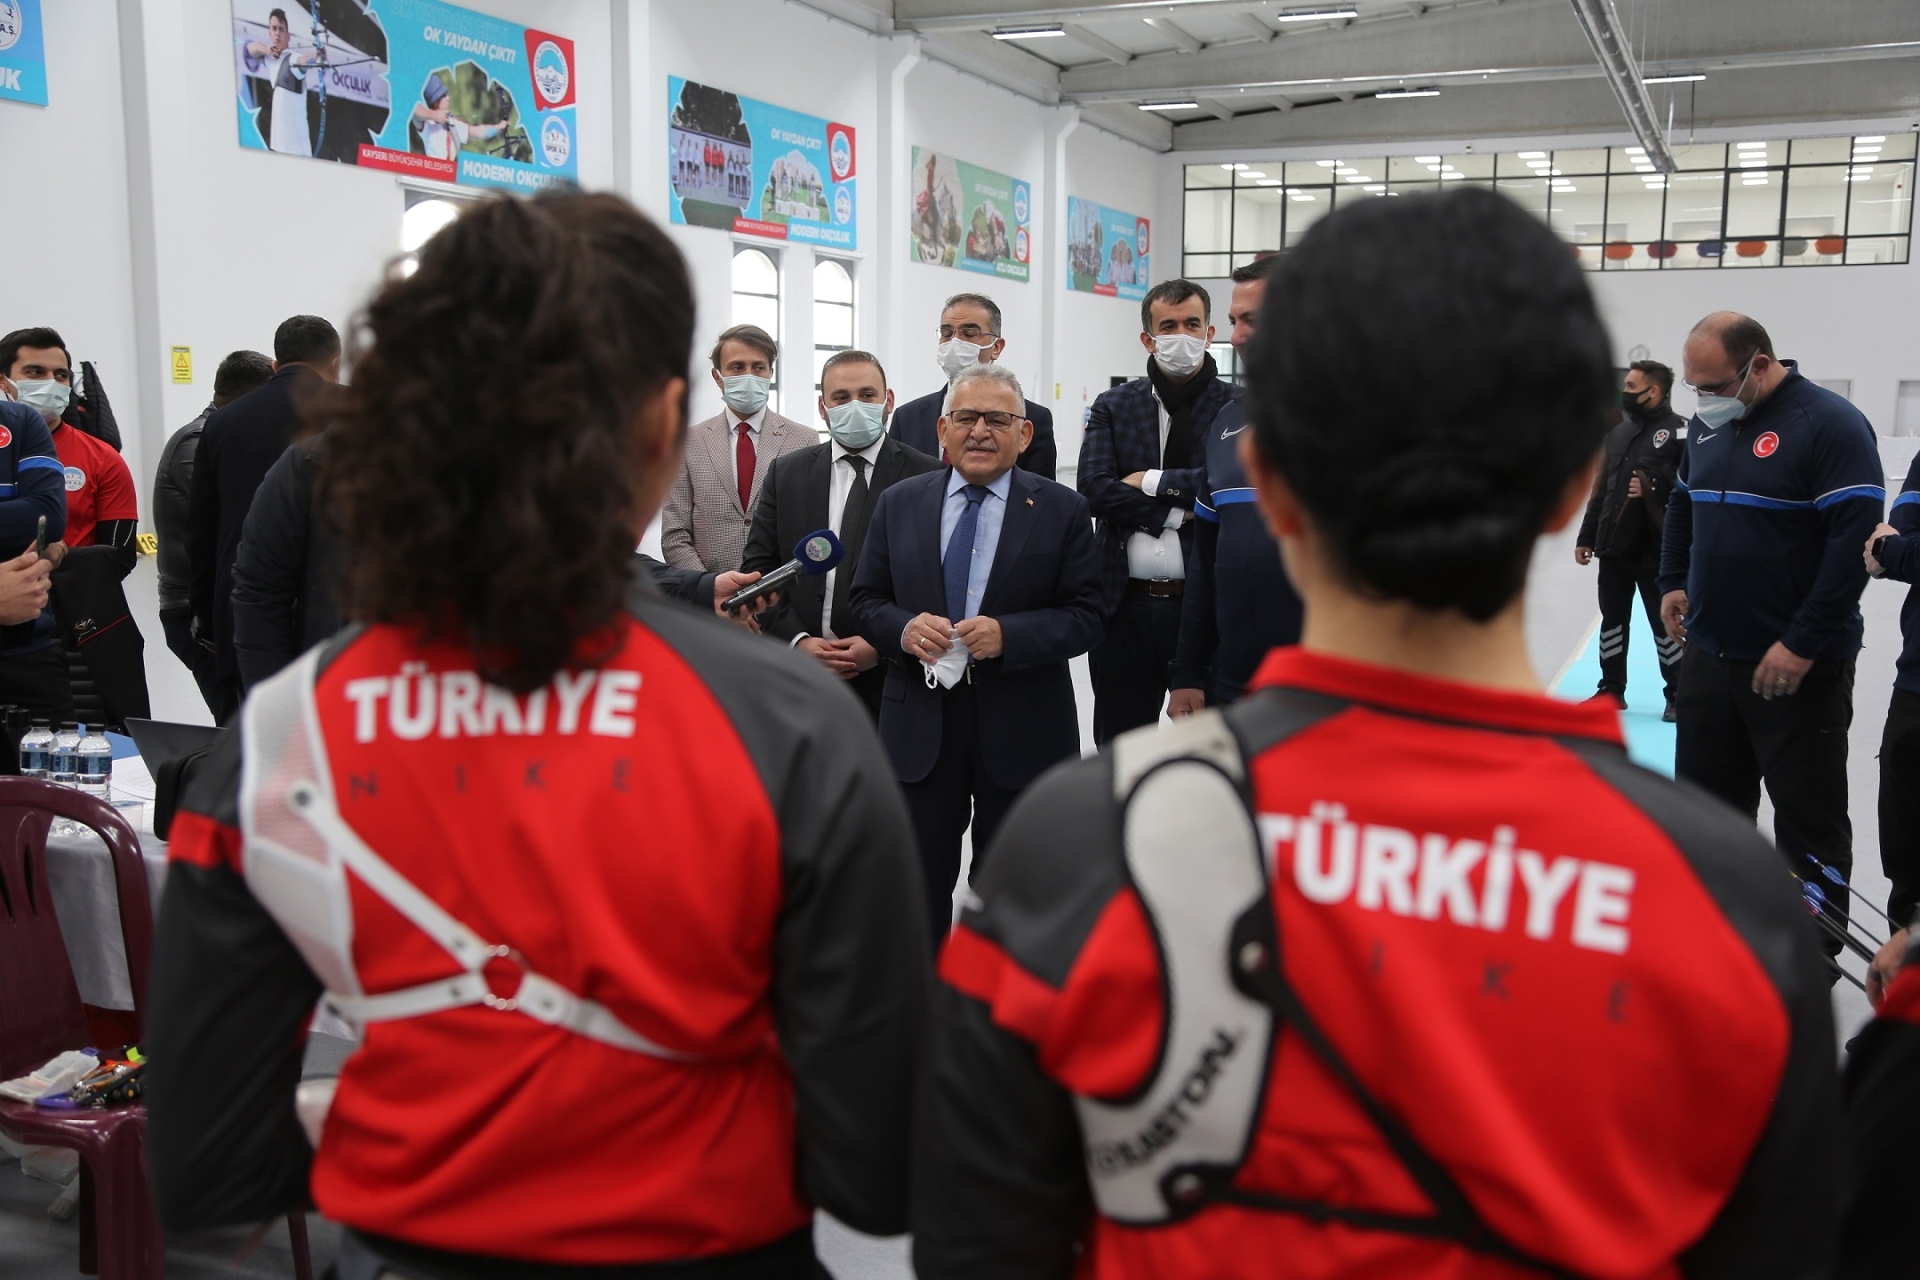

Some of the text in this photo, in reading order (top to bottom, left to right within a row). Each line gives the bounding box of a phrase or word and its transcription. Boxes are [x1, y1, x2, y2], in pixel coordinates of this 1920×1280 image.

[423, 25, 517, 64] OK YAYDAN ÇIKTI
[462, 159, 515, 184] MODERN
[790, 223, 820, 239] MODERN
[141, 536, 157, 550] 16
